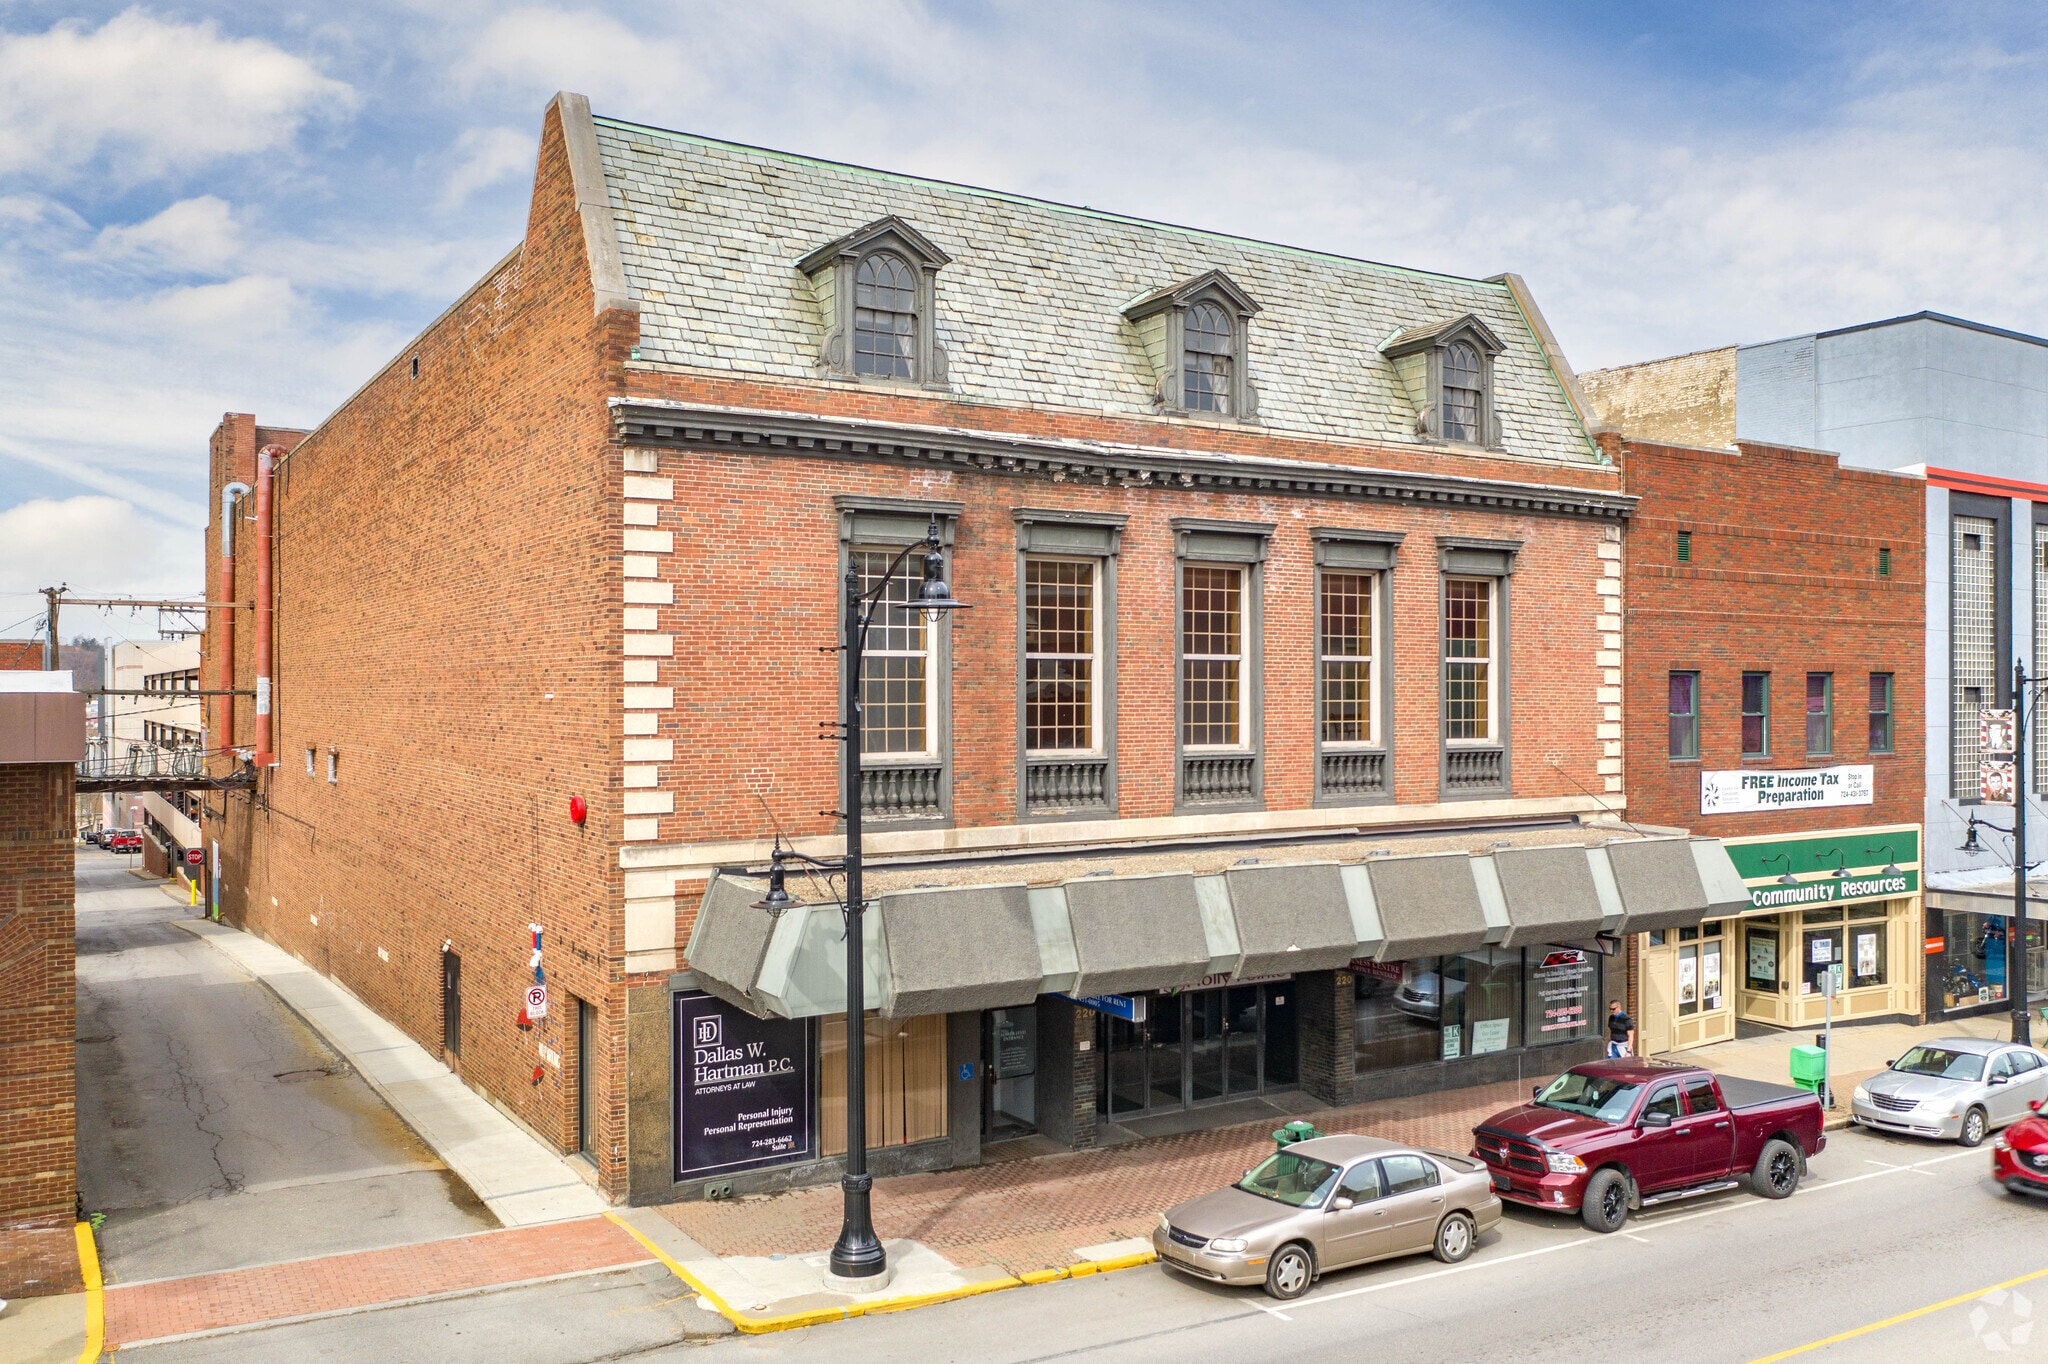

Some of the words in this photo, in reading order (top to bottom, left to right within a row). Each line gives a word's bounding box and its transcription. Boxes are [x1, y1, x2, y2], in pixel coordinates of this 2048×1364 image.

[1741, 774, 1775, 790] FREE
[1777, 774, 1817, 788] Income
[1819, 772, 1839, 786] Tax
[1758, 787, 1824, 806] Preparation
[187, 853, 202, 861] STOP
[1752, 883, 1835, 907] Community
[1841, 876, 1907, 897] Resources
[1372, 962, 1400, 974] CENTRE
[1335, 974, 1353, 985] 220
[1113, 998, 1127, 1008] RENT
[1075, 1008, 1096, 1019] 220
[694, 1046, 743, 1066] Dallas
[746, 1042, 767, 1058] W.
[694, 1062, 764, 1083] Hartman
[768, 1057, 794, 1072] P.C.
[695, 1083, 733, 1096] ATTORNEYS
[741, 1081, 756, 1089] LAW
[737, 1108, 770, 1121] Personal
[771, 1106, 793, 1118] Injury
[704, 1123, 736, 1136] Personal
[738, 1115, 793, 1131] Representation
[771, 1142, 787, 1151] Suite
